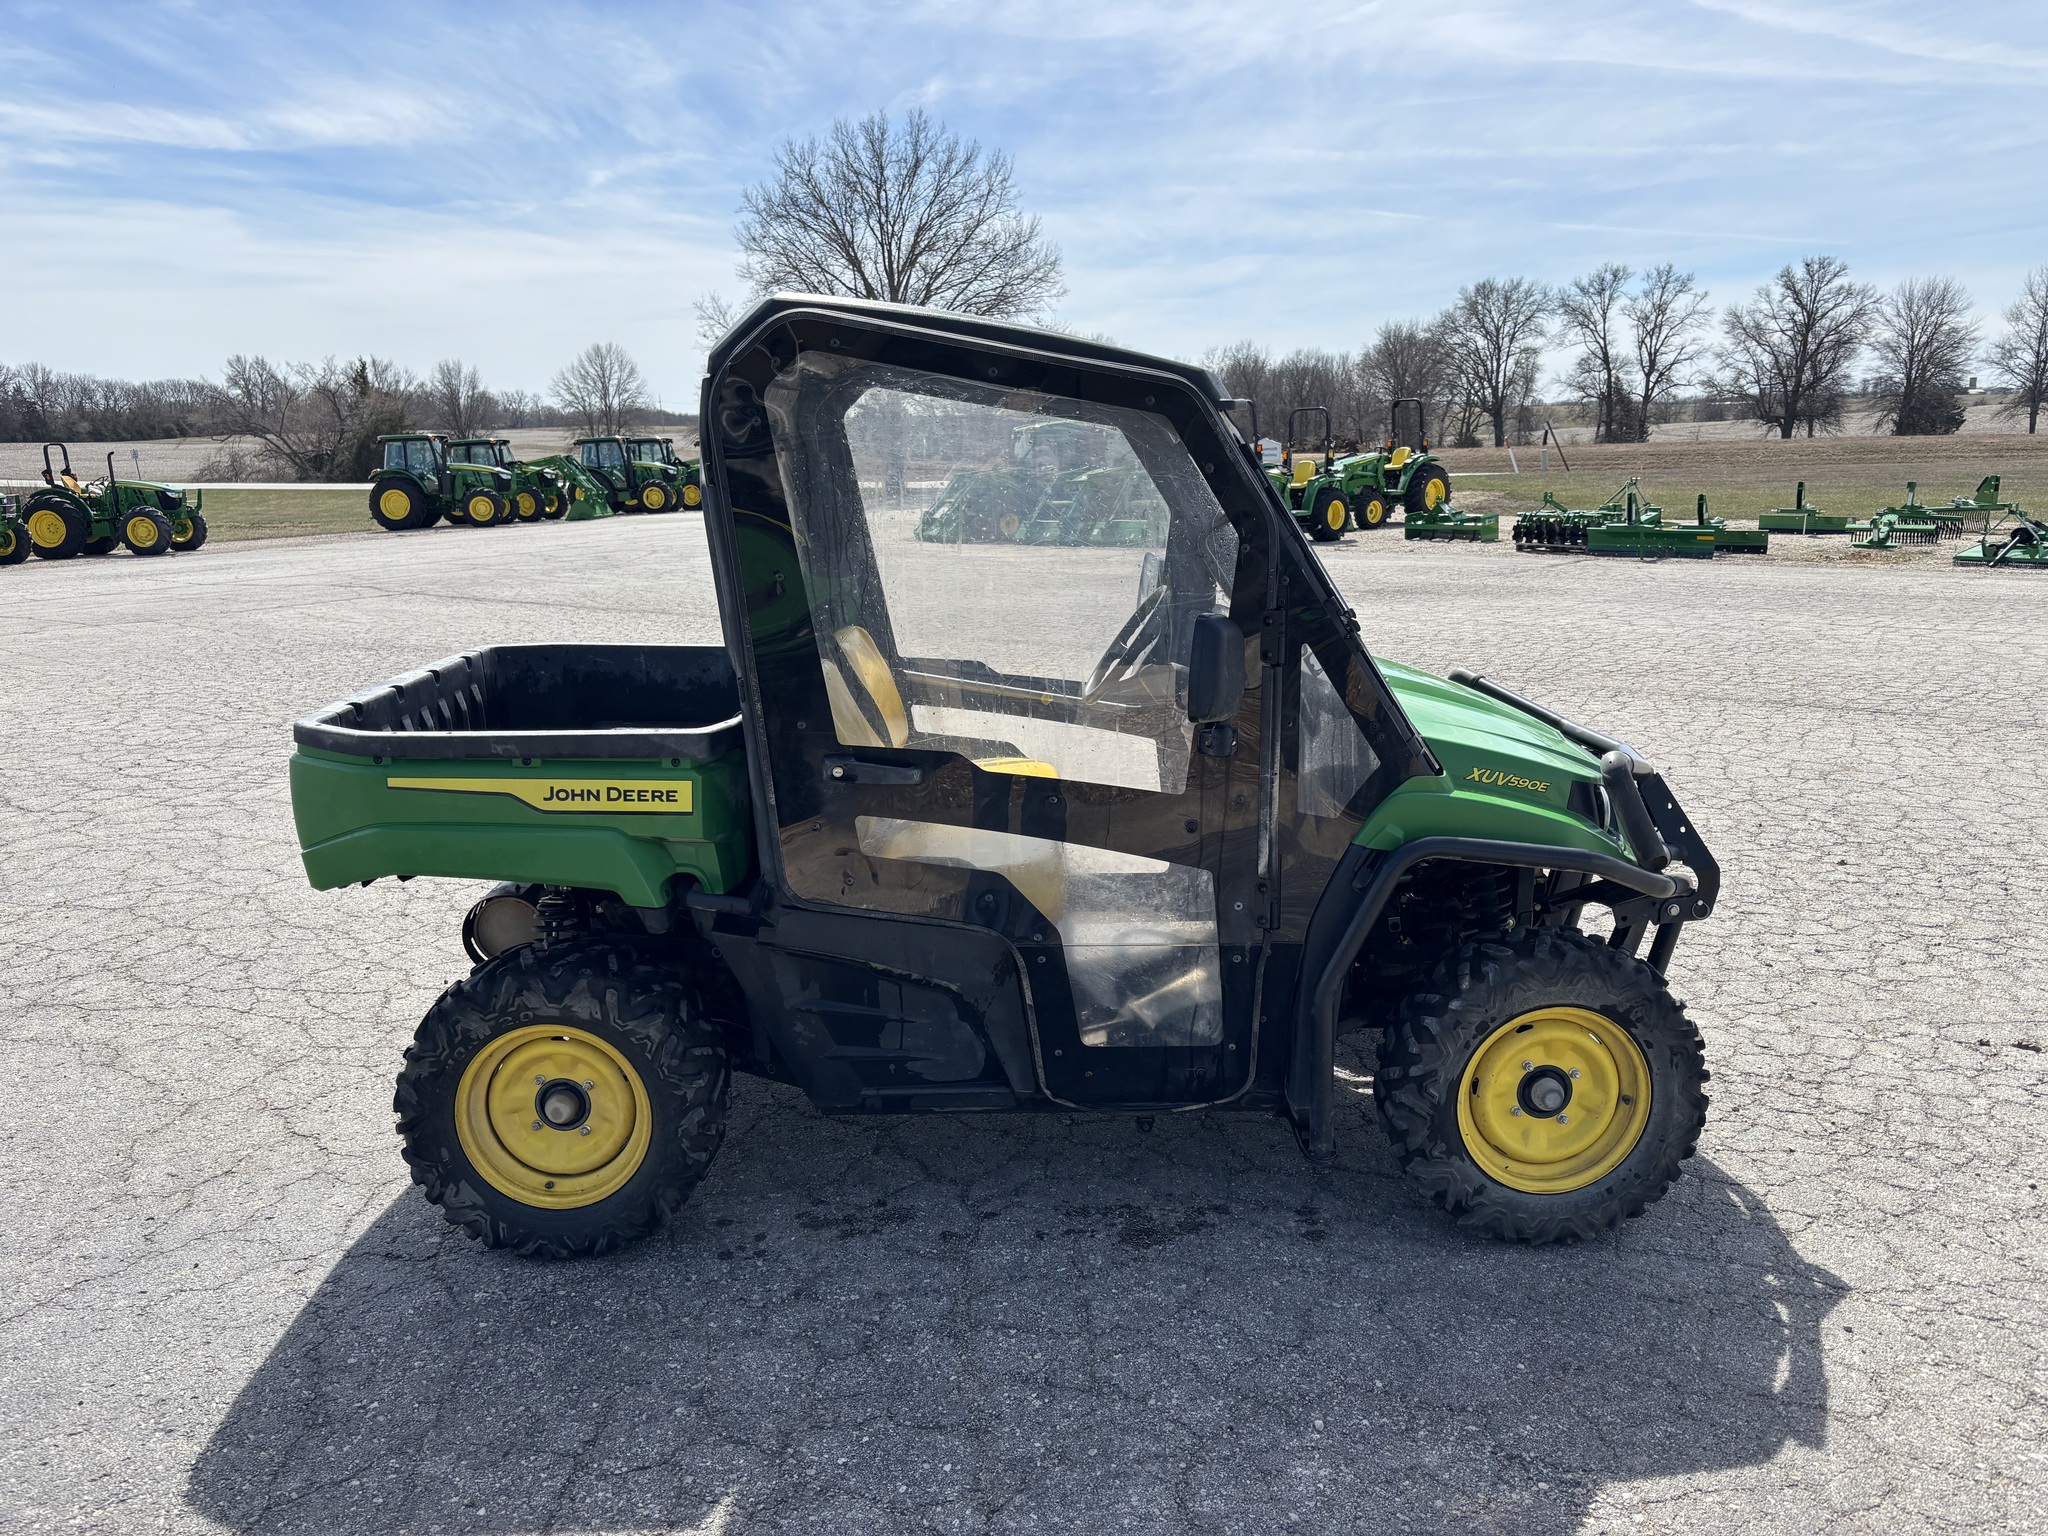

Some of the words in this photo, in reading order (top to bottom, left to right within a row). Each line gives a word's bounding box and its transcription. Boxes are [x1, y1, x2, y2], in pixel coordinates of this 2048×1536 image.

[1464, 766, 1551, 792] XUV590E
[542, 786, 601, 802] JOHN
[606, 786, 679, 802] DEERE
